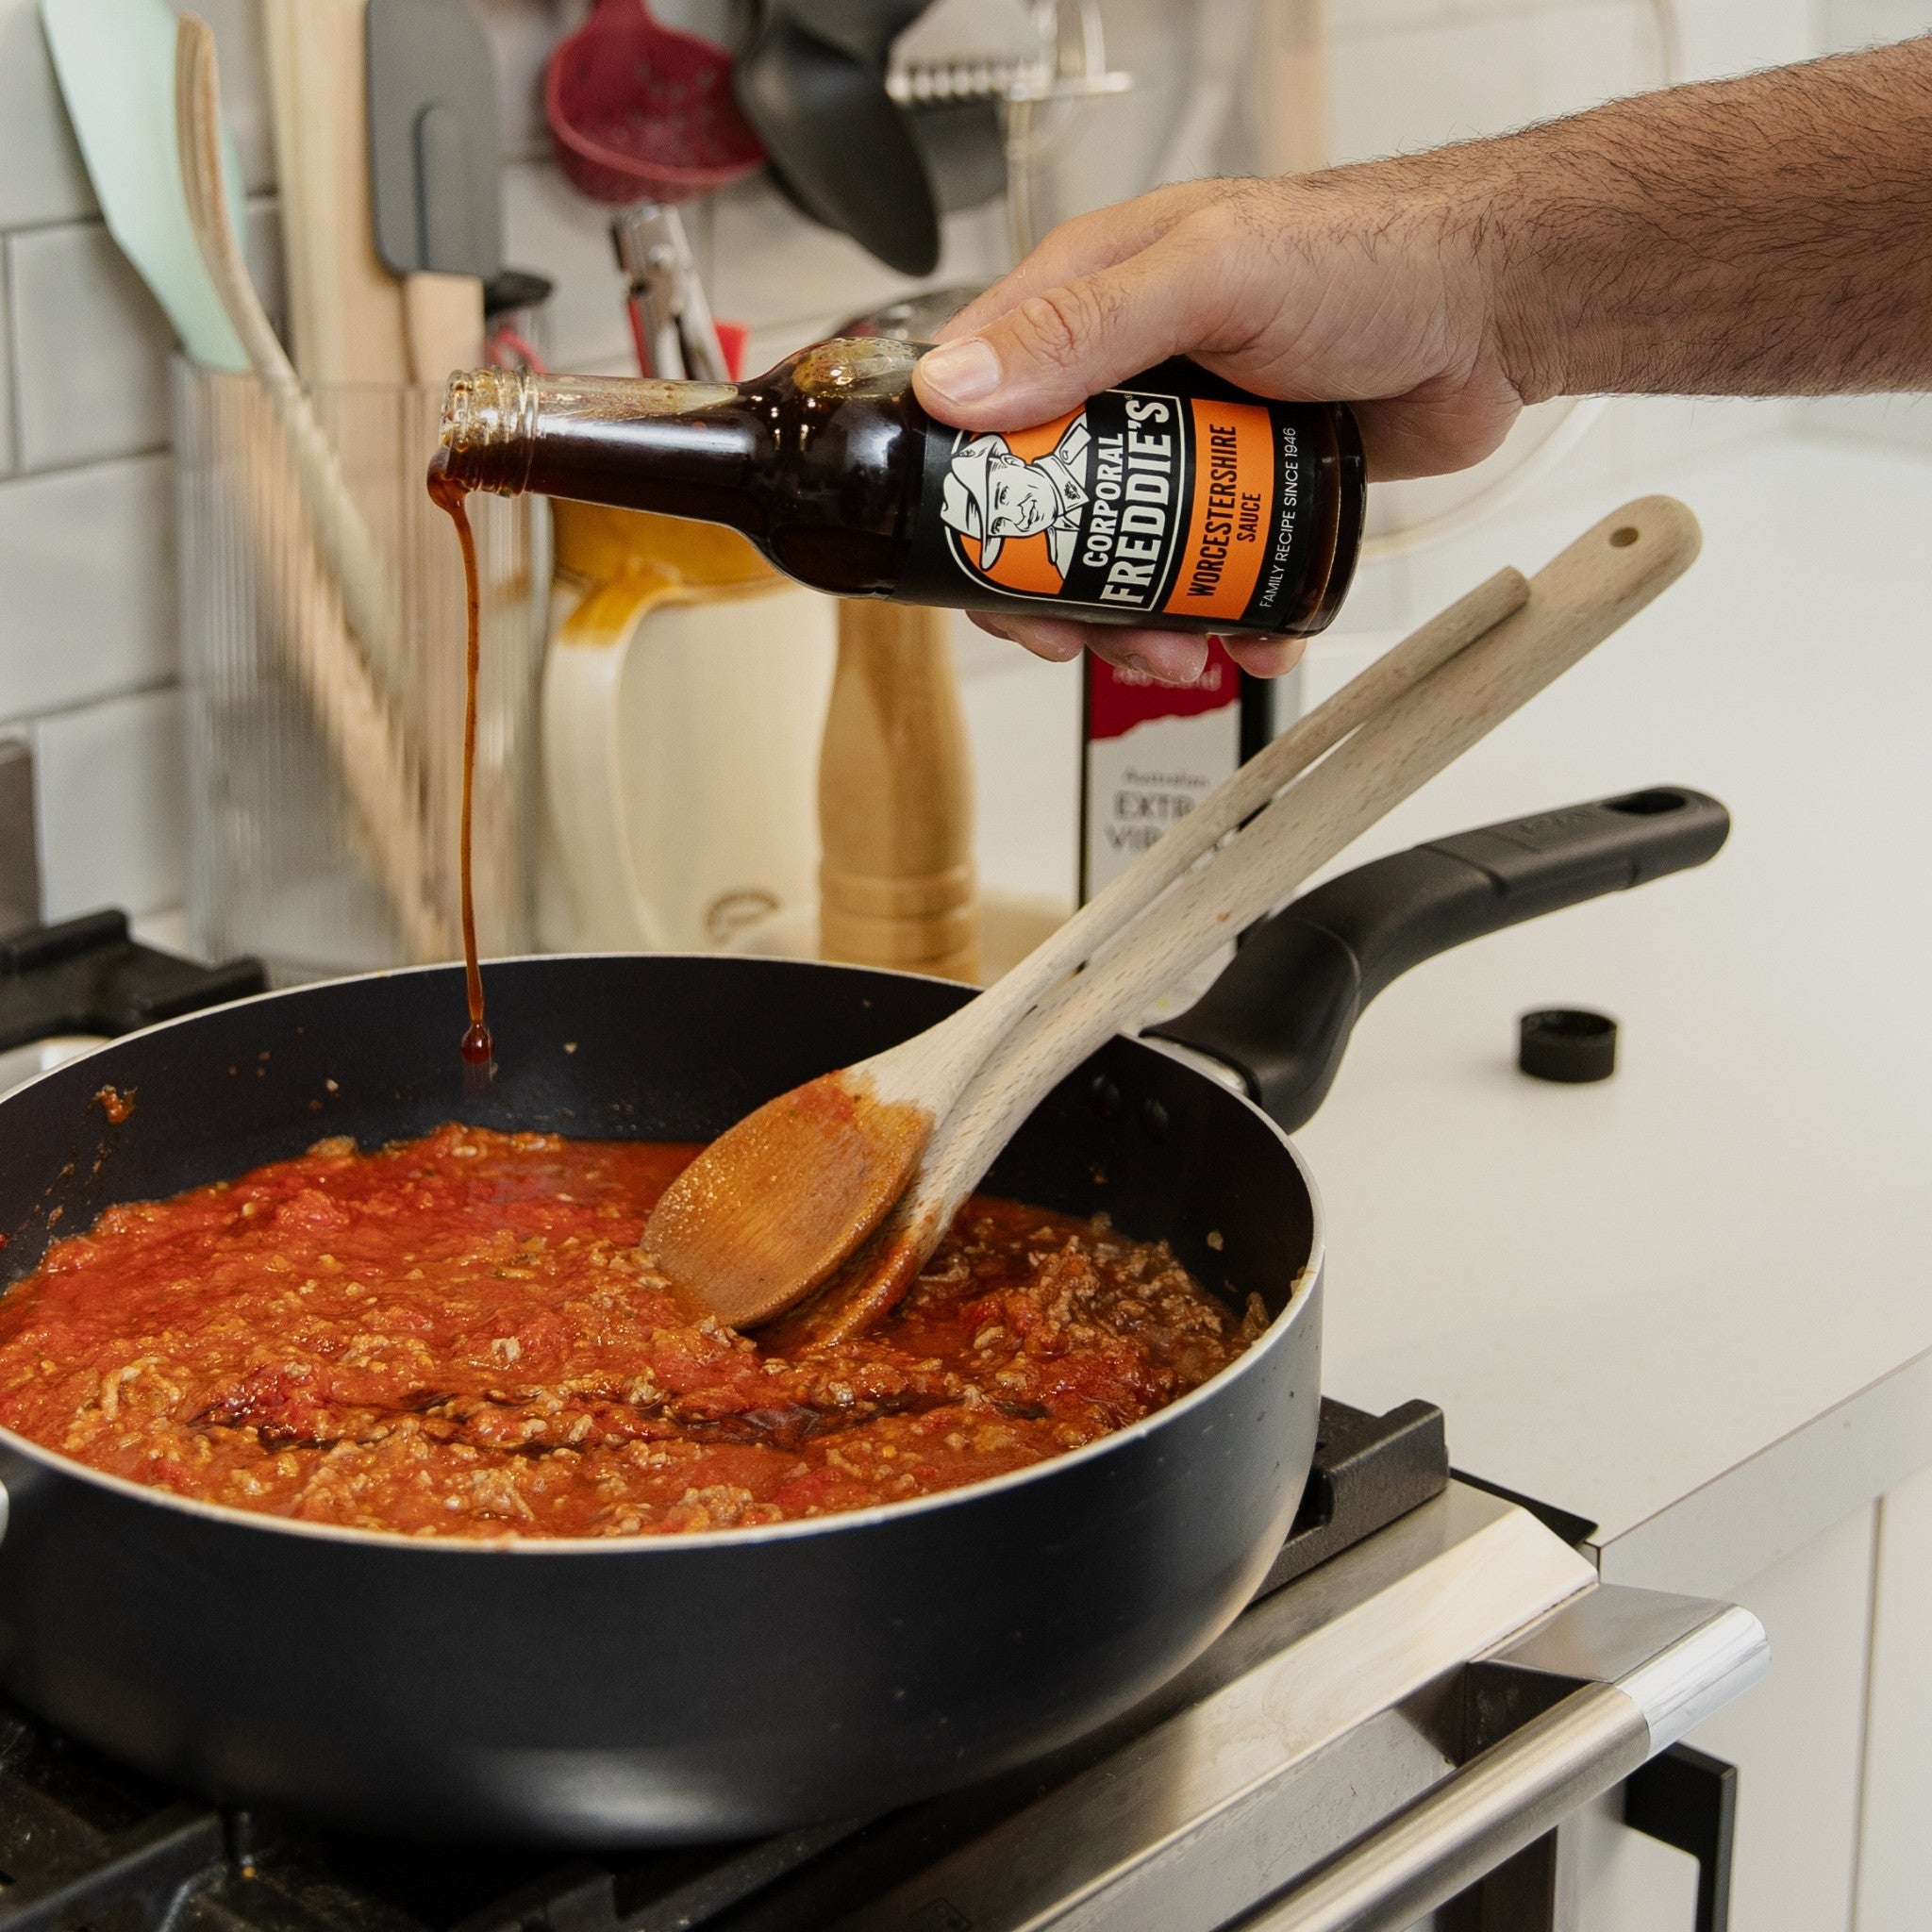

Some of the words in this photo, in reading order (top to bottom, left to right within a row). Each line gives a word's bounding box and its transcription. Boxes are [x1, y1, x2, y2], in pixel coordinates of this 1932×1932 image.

[1282, 427, 1298, 458] 1946
[1082, 433, 1124, 568] CORPORAL
[1099, 399, 1172, 604] FREDDIE'S
[1283, 460, 1299, 507] SINCE
[1186, 424, 1238, 597] WORCESTERSHIRE
[1236, 491, 1261, 542] SAUCE
[1274, 510, 1296, 561] RECIPE
[1258, 564, 1285, 608] FAMILY
[1112, 790, 1198, 820] EXTR
